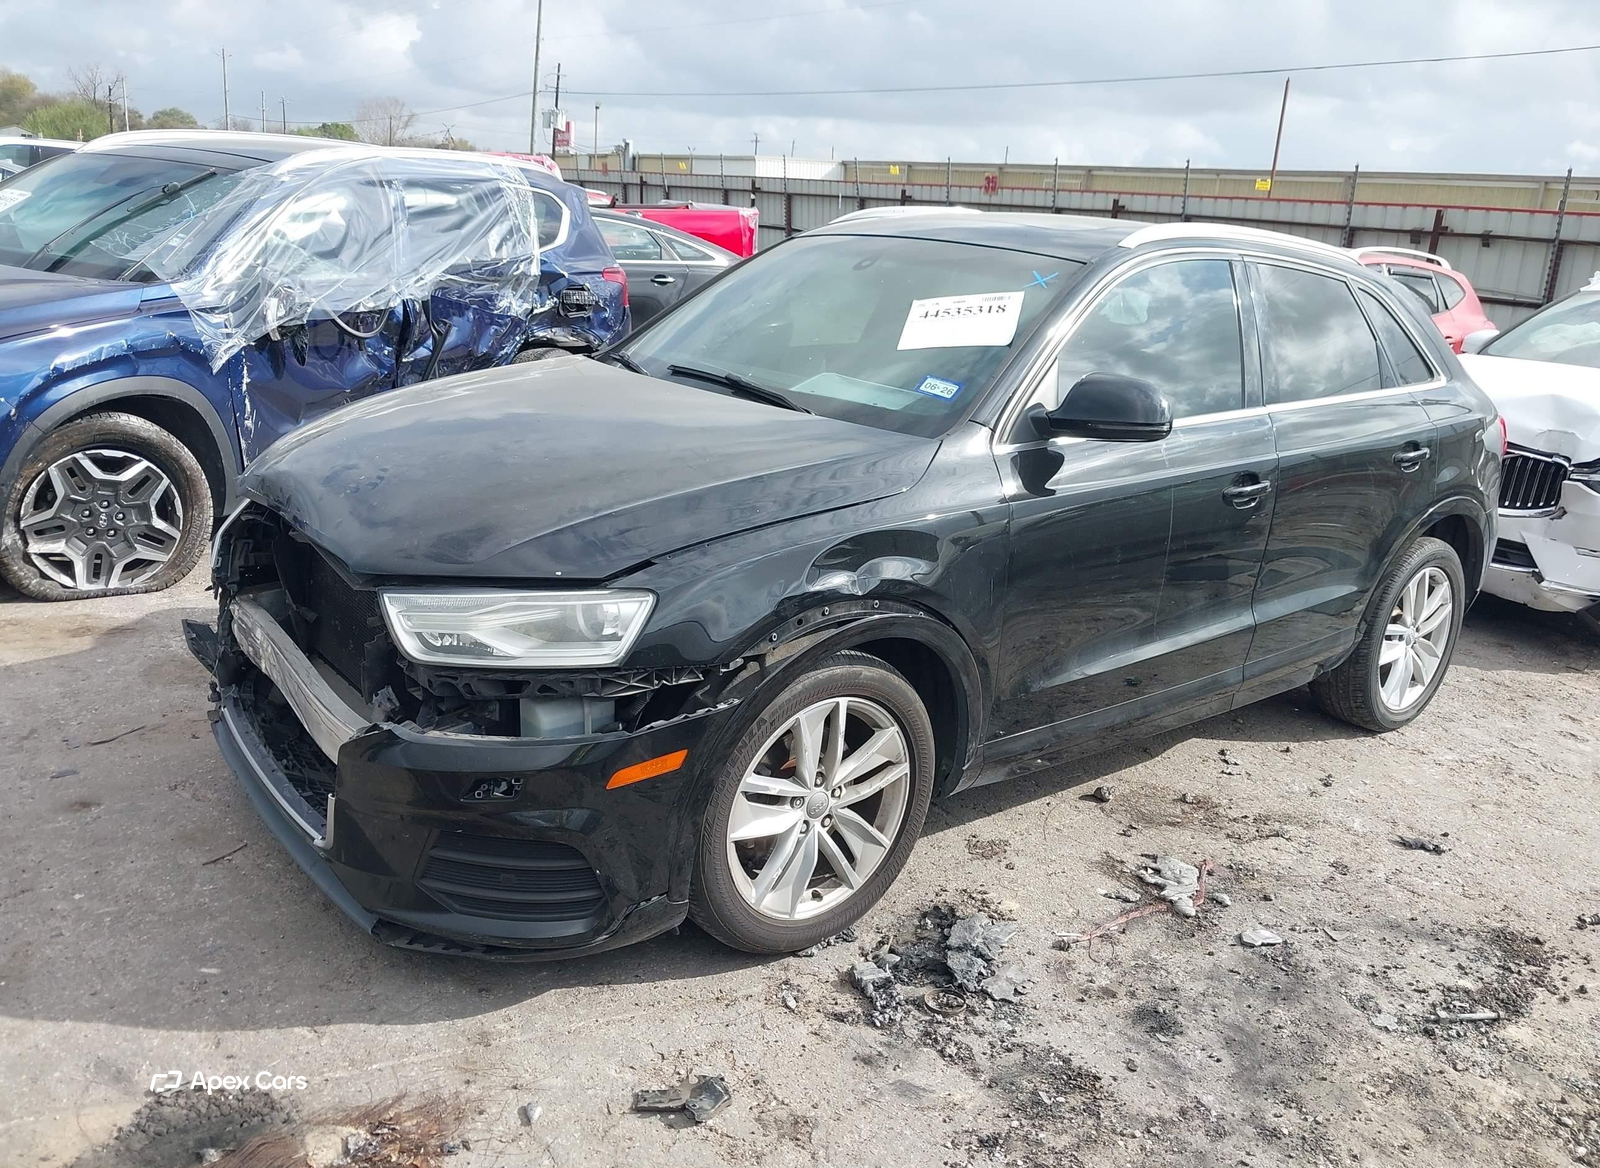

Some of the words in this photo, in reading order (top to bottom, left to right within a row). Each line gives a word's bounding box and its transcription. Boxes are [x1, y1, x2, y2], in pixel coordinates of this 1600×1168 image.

[919, 304, 1006, 319] 44535318
[924, 382, 938, 391] 06
[940, 386, 955, 396] 26
[710, 716, 768, 807] POTENZA
